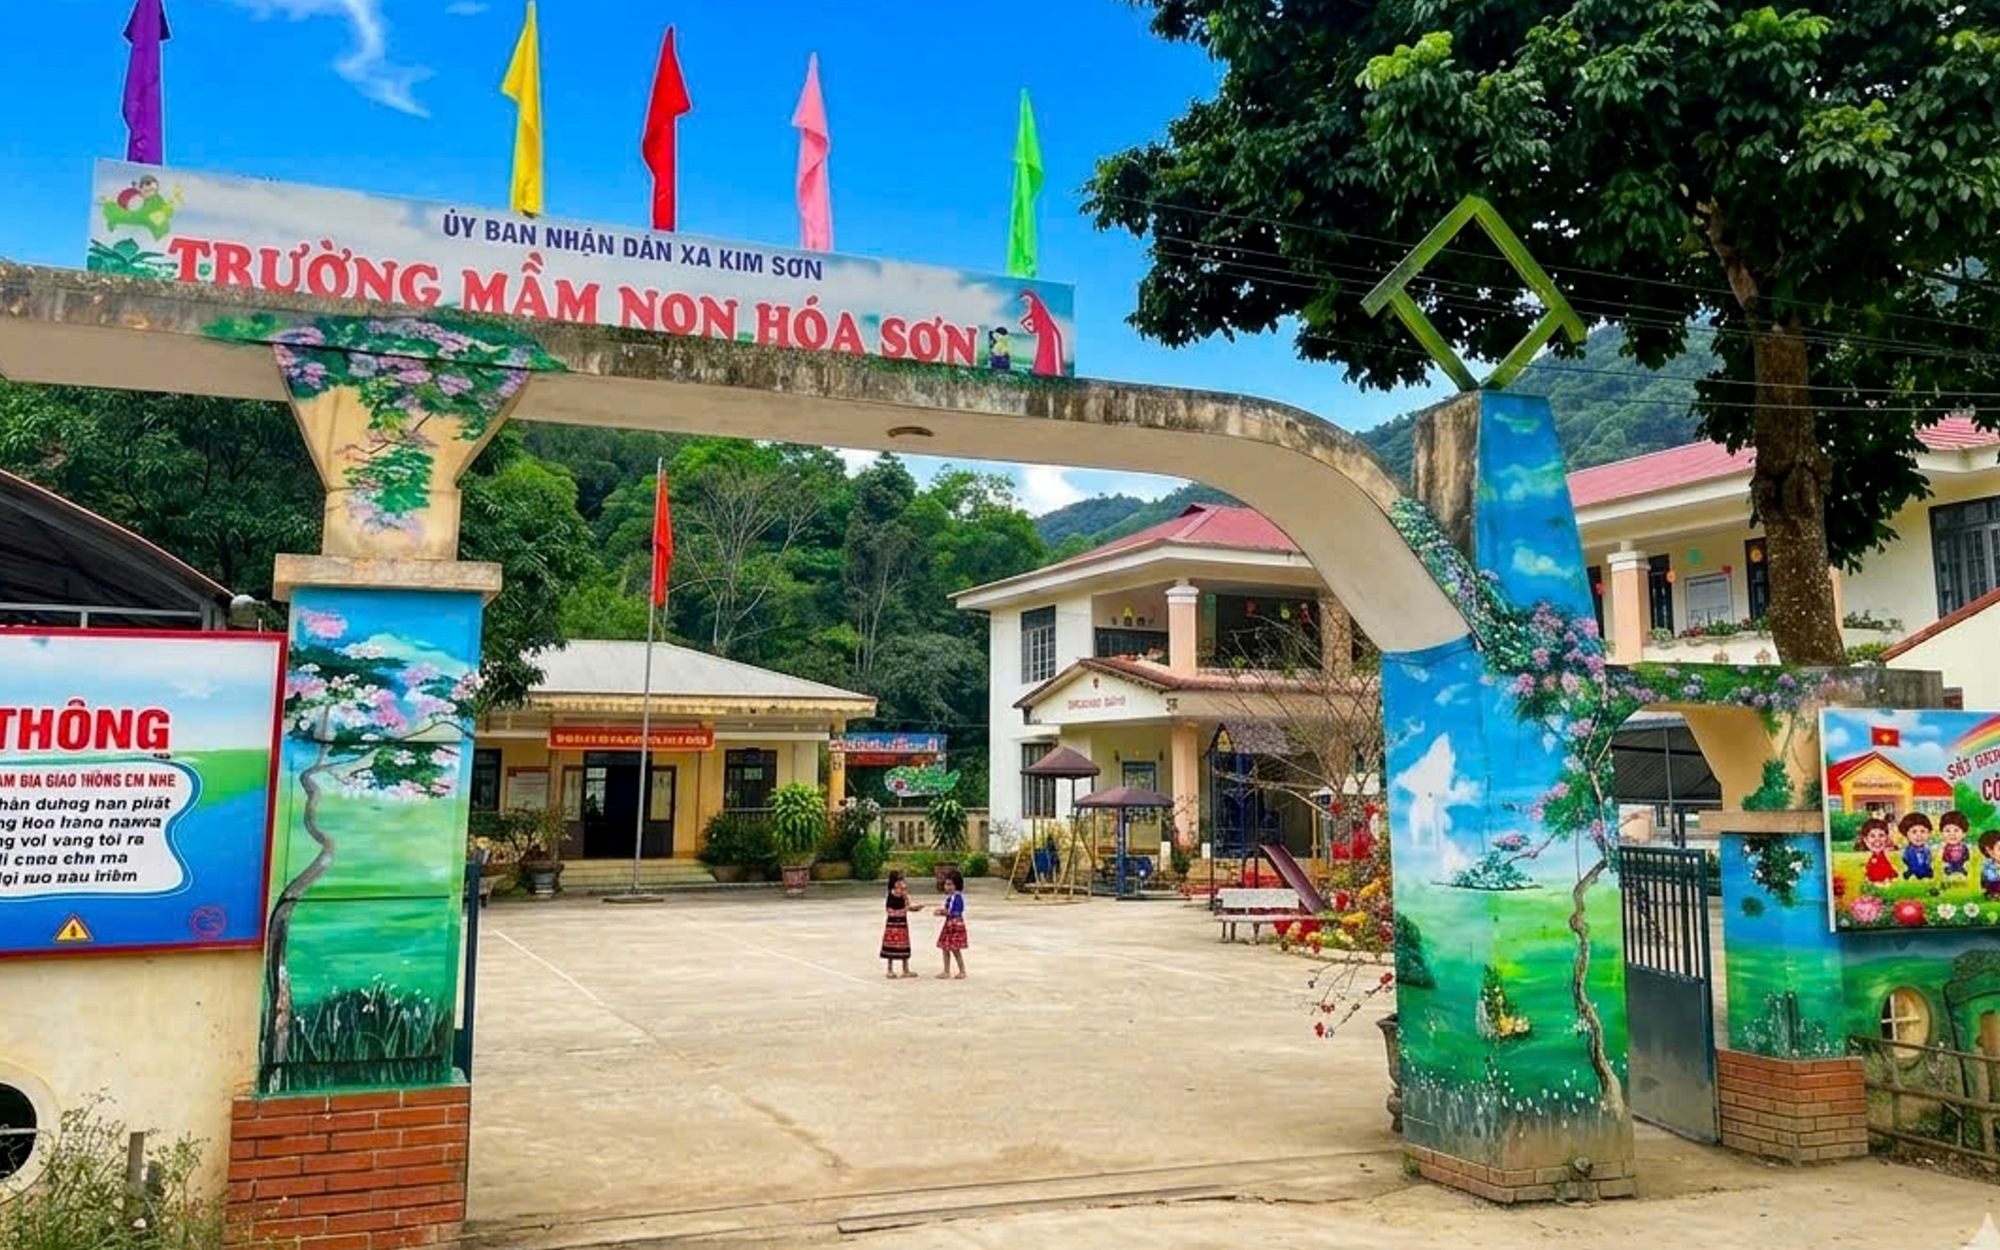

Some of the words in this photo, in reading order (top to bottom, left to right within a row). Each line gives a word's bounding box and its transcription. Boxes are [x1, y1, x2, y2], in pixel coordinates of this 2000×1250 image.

[486, 220, 536, 245] BAN
[719, 249, 763, 273] KIM
[772, 256, 822, 281] SƠN
[168, 238, 442, 307] TRƯỜNG
[462, 251, 600, 324] MẦM
[618, 286, 739, 340] NON
[756, 295, 866, 357] HÓA
[881, 316, 977, 367] SƠN
